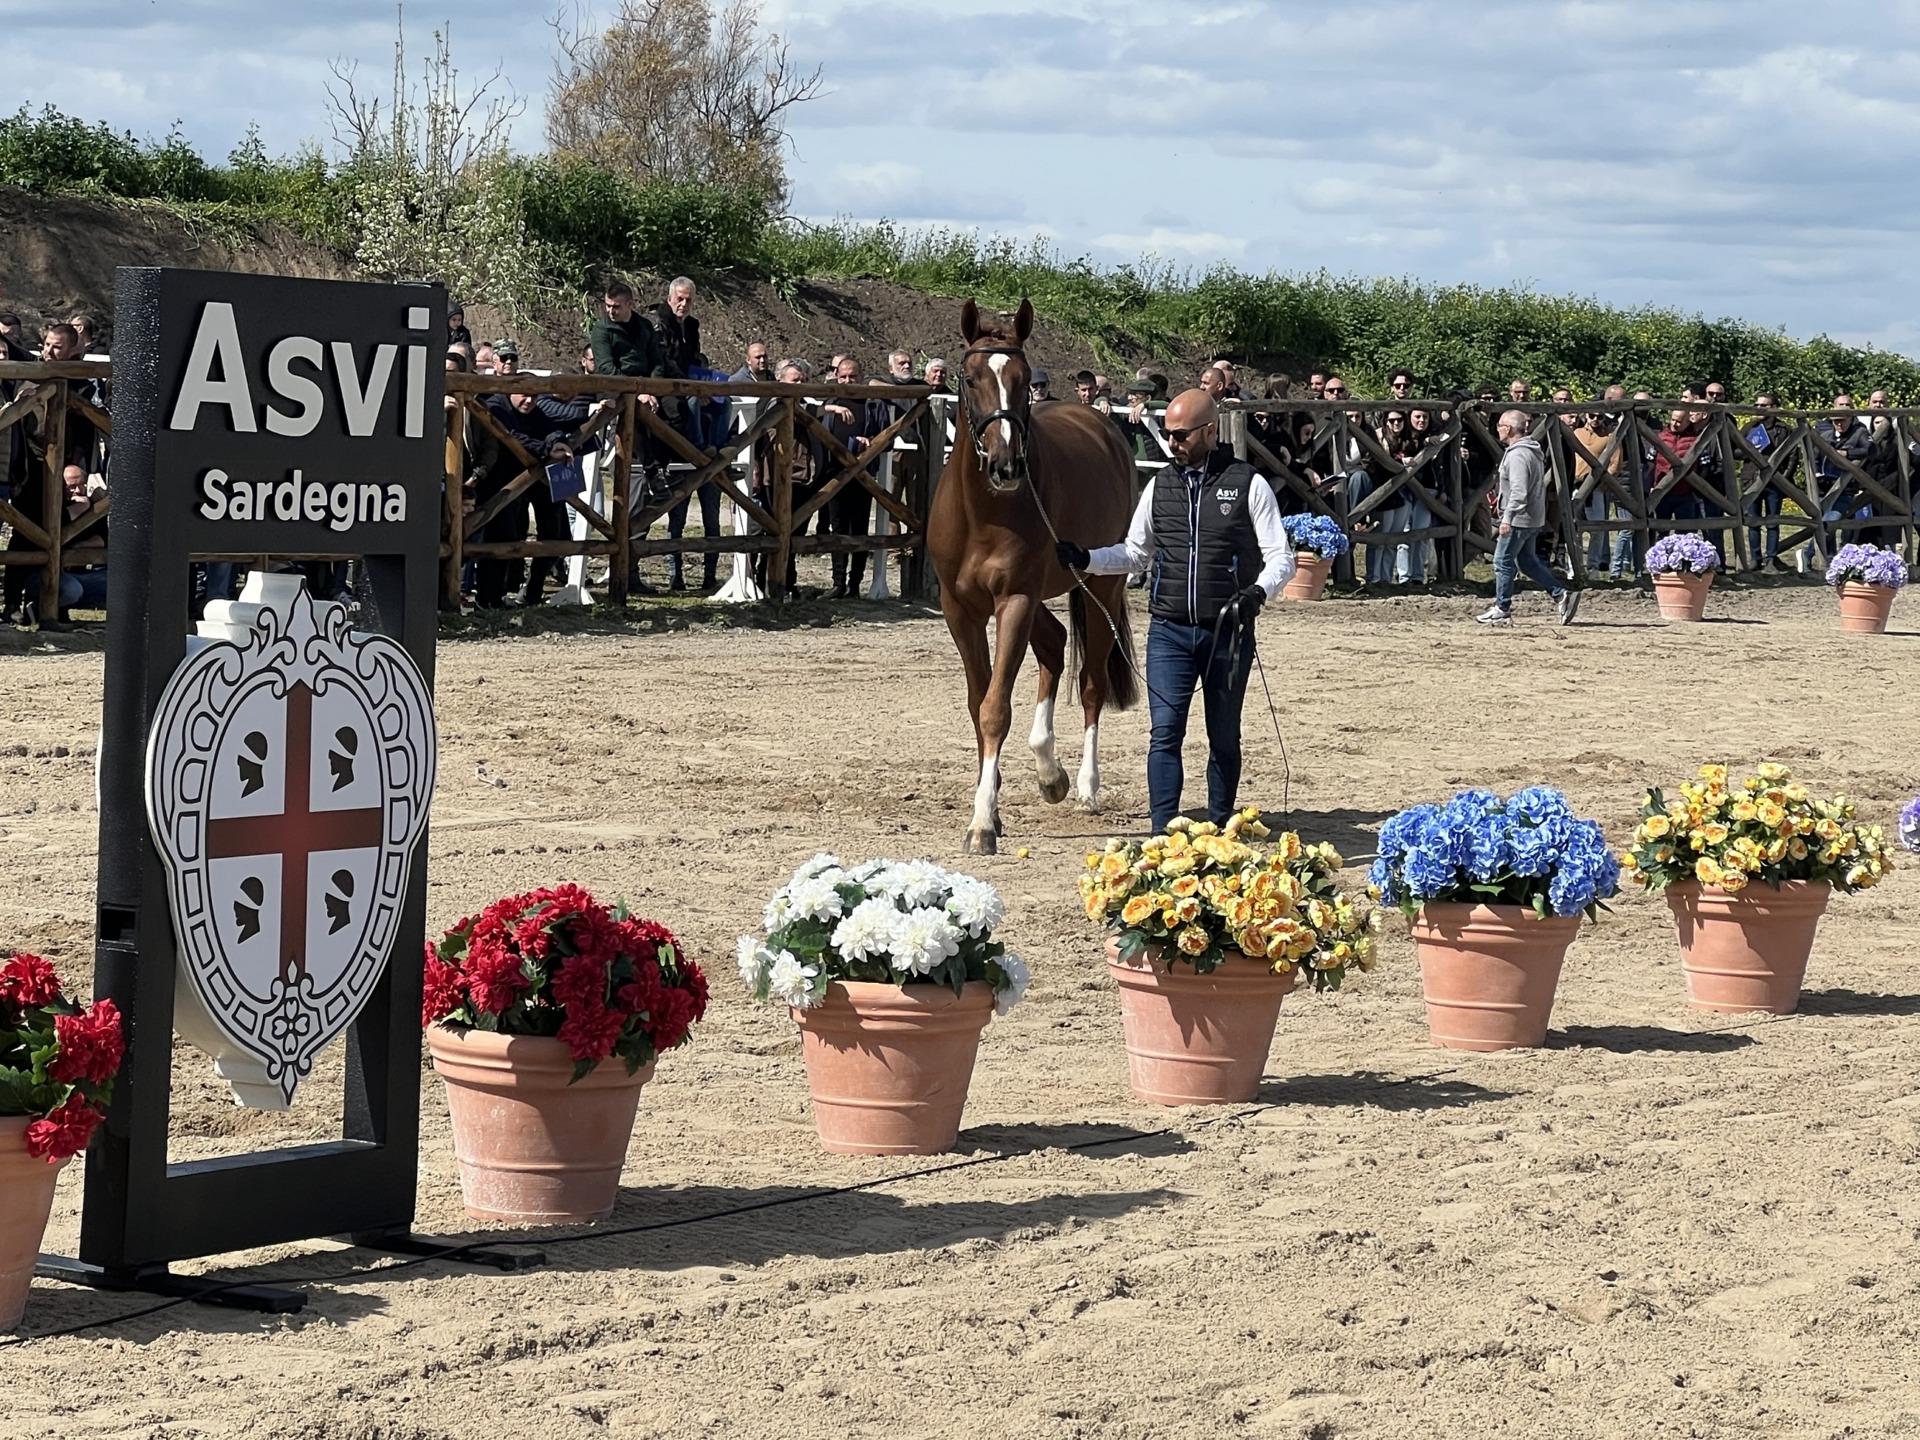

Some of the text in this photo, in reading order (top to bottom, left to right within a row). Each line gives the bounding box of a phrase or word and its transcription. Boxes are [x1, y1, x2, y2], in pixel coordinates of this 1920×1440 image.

[169, 301, 430, 438] Asvi
[200, 468, 407, 532] Sardegna
[1215, 488, 1239, 497] Asvi
